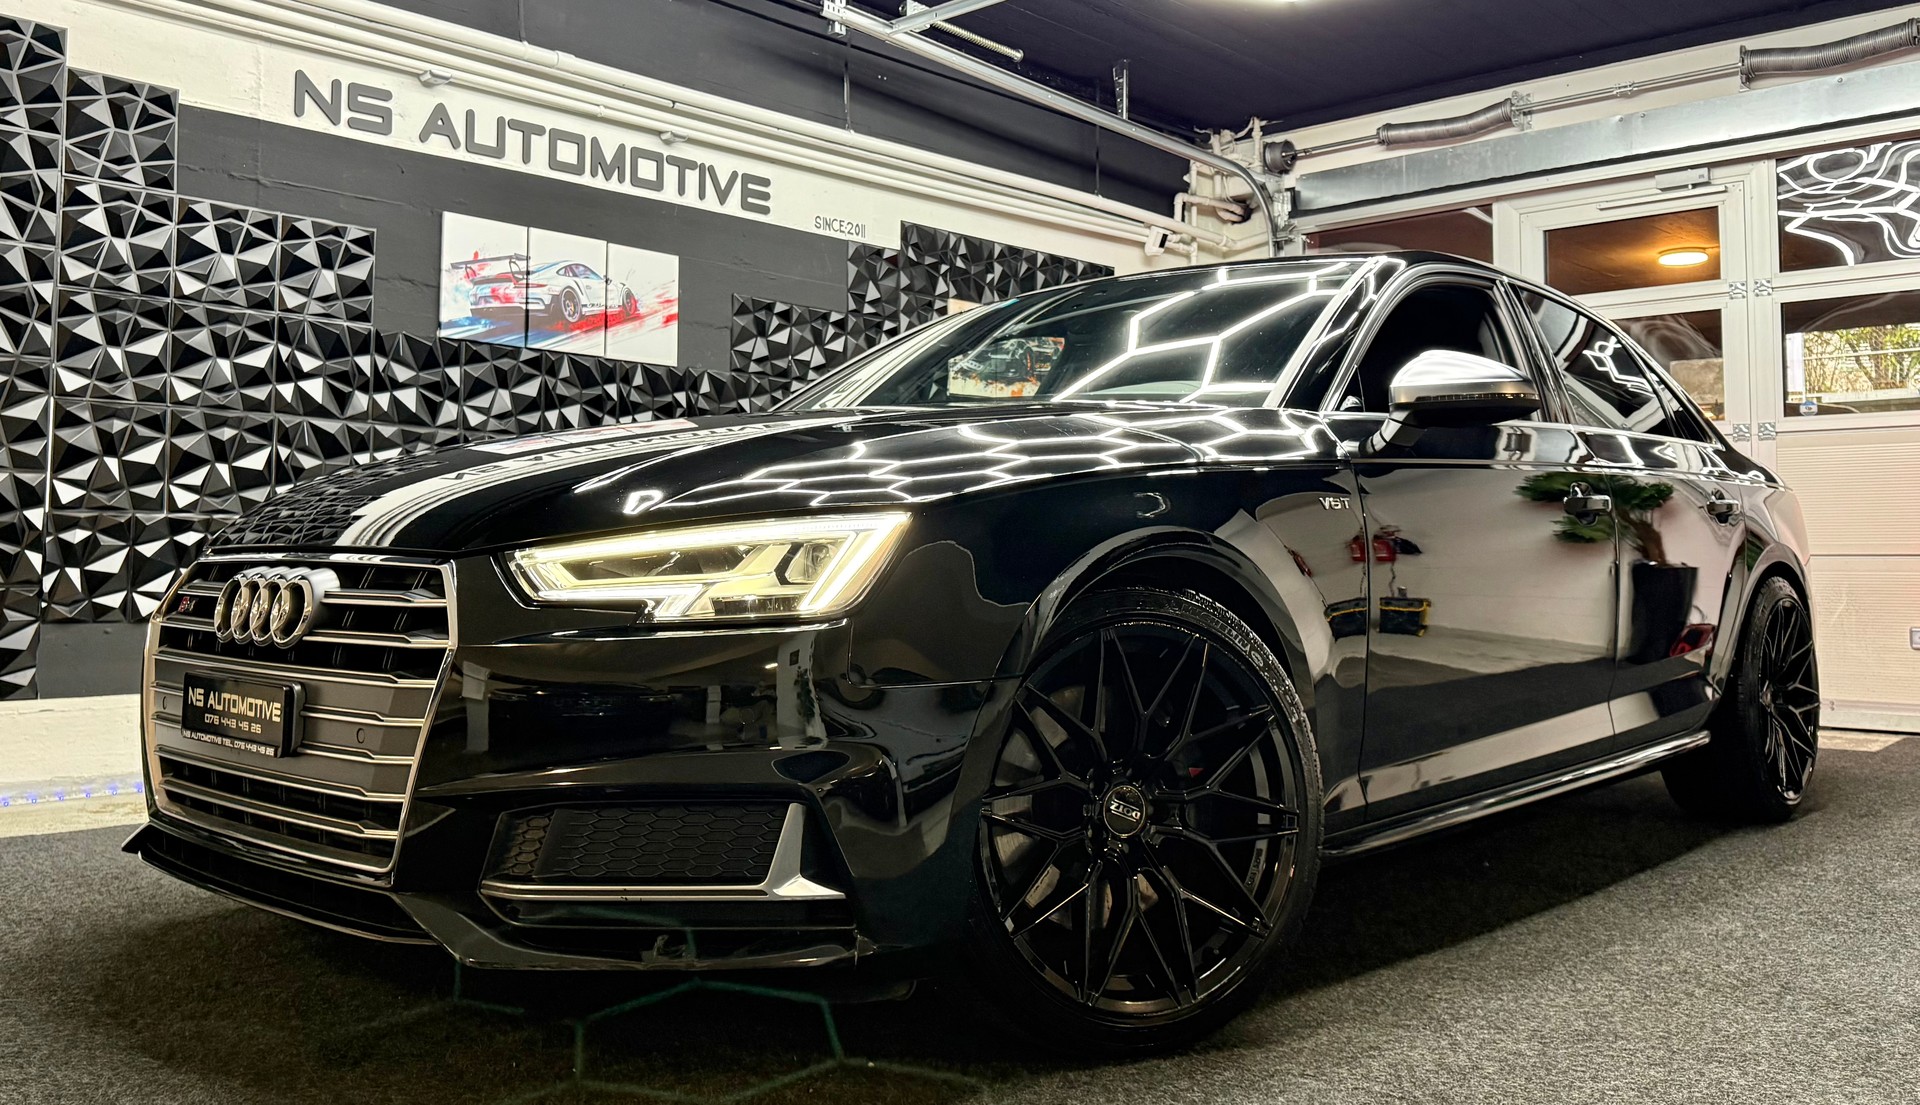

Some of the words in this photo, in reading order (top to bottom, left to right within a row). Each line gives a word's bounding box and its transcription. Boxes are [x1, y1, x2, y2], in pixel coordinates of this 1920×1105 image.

[294, 69, 393, 136] NS
[419, 102, 771, 216] AUTOMOTIVE
[188, 686, 204, 707] NS
[207, 691, 282, 722] AUTOMOTIVE
[204, 713, 219, 725] 076
[221, 717, 237, 728] 443
[238, 720, 249, 731] 45
[250, 723, 261, 734] 26
[191, 731, 222, 745] AUTOMOTIVE
[1110, 801, 1141, 820] DOTZ
